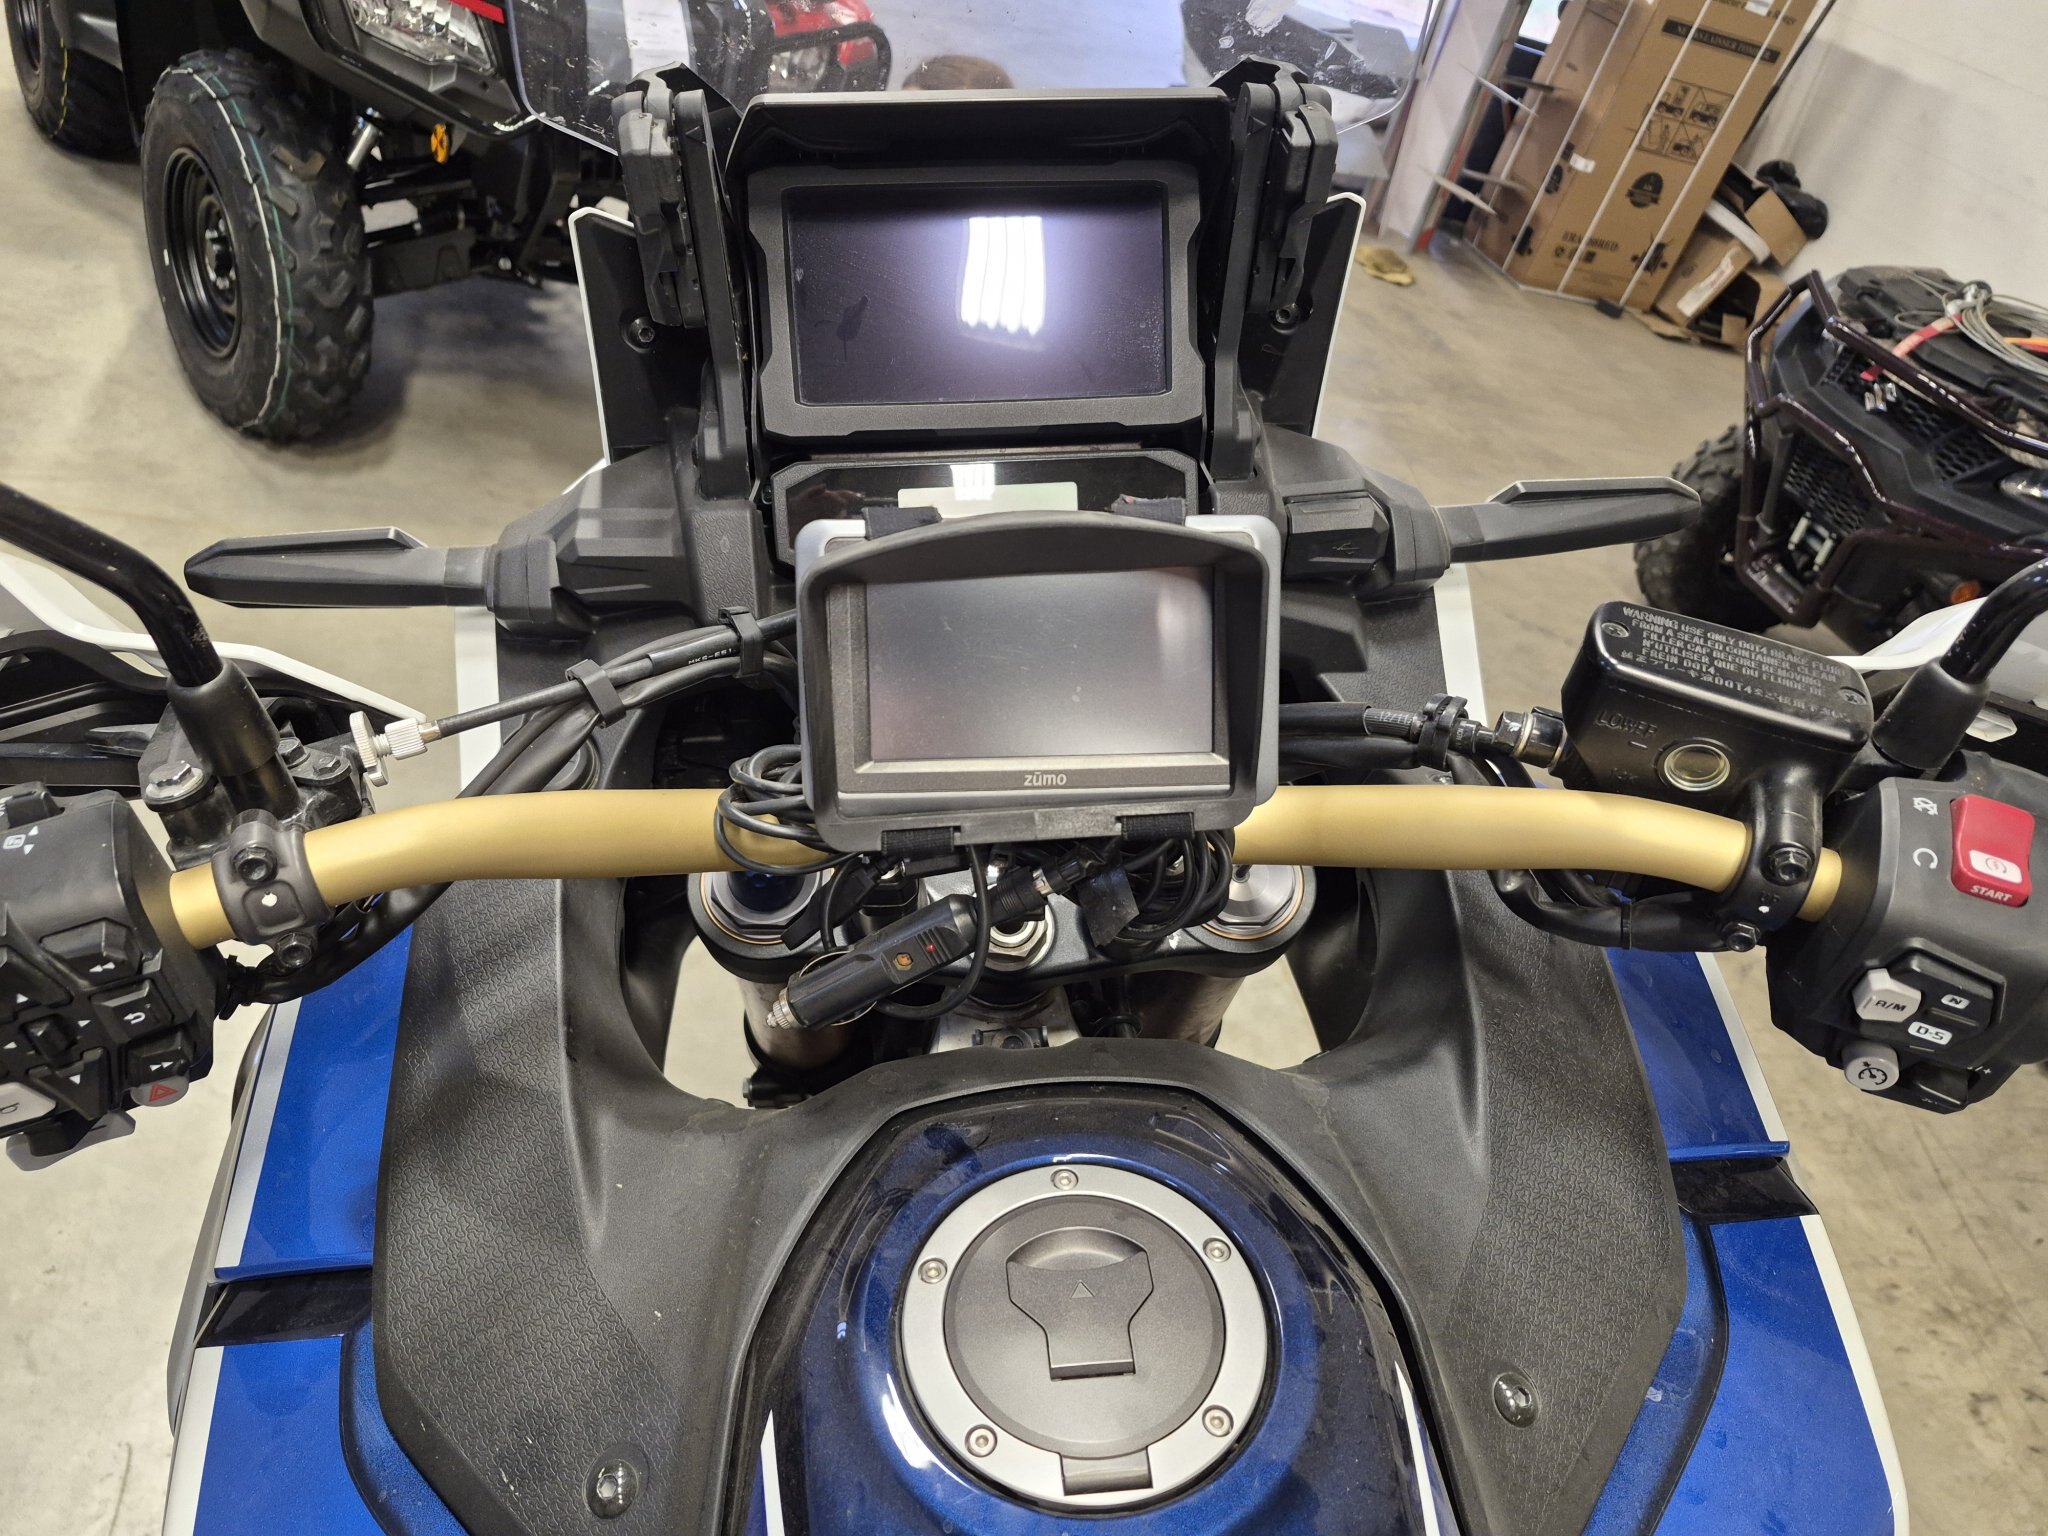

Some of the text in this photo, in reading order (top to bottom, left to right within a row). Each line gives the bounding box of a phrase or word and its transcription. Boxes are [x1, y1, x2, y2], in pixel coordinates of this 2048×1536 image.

[1623, 606, 1679, 630] WARNING
[1681, 624, 1705, 637] USE
[1707, 631, 1735, 645] ONLY
[1738, 640, 1768, 654] DOT4
[1770, 649, 1808, 664] BRAKE
[1643, 630, 1684, 648] FILLER
[1687, 642, 1710, 654] CAP
[1713, 649, 1759, 668] BEFORE
[1631, 618, 1664, 634] FROM
[1666, 628, 1674, 637] A
[1676, 631, 1723, 650] SEALED
[1797, 665, 1836, 682] CLEAN
[1642, 647, 1720, 676] FREIN DOT4.
[1642, 638, 1710, 664] N'UTILISER
[1714, 659, 1739, 672] QUE
[1742, 667, 1758, 678] DU
[1762, 673, 1806, 692] FLUIDE
[1024, 771, 1067, 786] zūmo
[1970, 885, 2012, 901] START
[1875, 999, 1907, 1012] A/M
[1916, 1025, 1945, 1041] D-S
